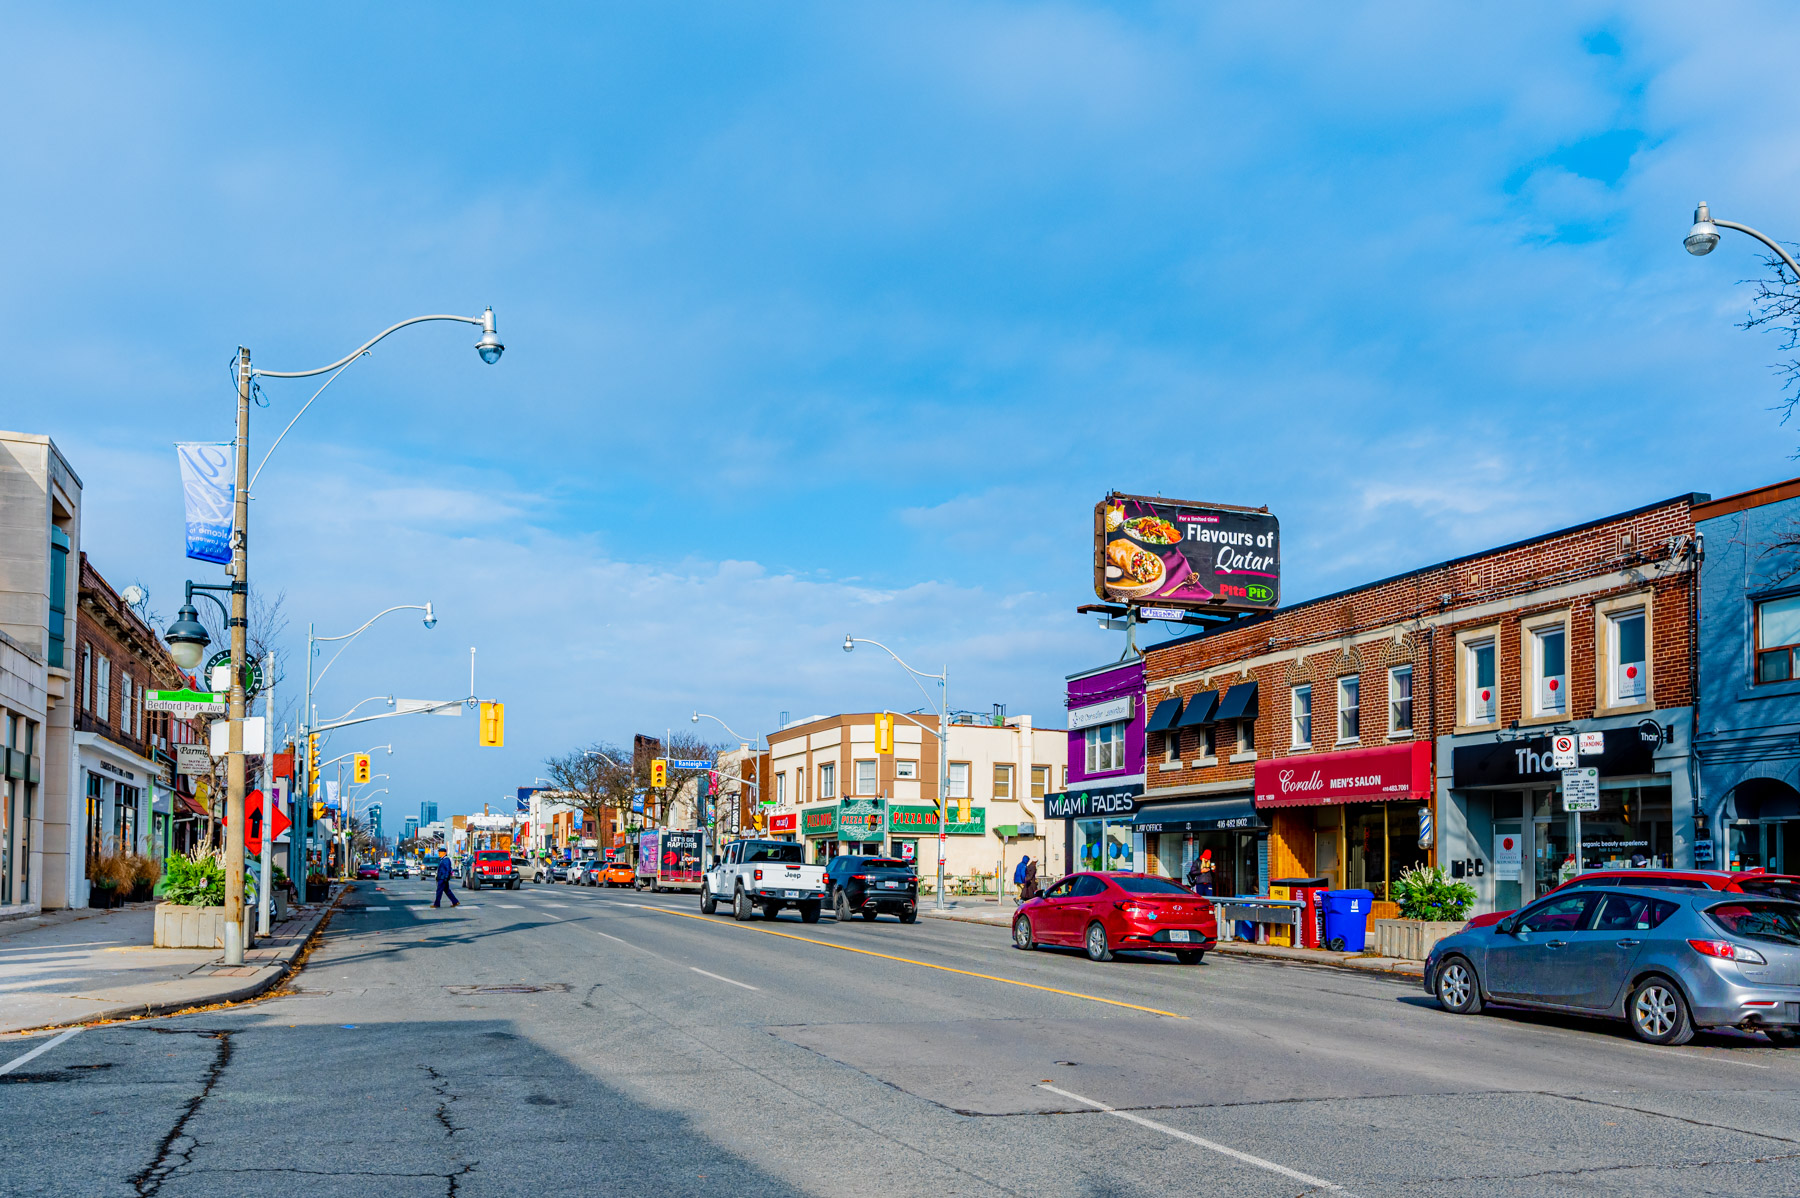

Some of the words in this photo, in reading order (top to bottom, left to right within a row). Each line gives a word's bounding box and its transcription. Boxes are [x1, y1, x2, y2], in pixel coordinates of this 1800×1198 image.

[1187, 524, 1254, 546] Flavours
[1257, 532, 1274, 548] of
[1215, 546, 1274, 573] Qatar
[1220, 584, 1246, 597] Pita
[1248, 586, 1266, 599] Pit
[148, 700, 182, 710] Bedford
[184, 702, 204, 712] Park
[207, 703, 222, 712] Ave
[1641, 732, 1658, 742] Thair
[678, 760, 702, 768] Ranleigh
[1279, 770, 1324, 794] Corallo
[1330, 777, 1354, 789] MEN'S
[1355, 775, 1381, 787] SALON
[1049, 796, 1086, 816] MIAMI
[1092, 792, 1133, 813] FADES
[807, 813, 820, 828] PIZZA
[820, 812, 832, 826] NOVA
[842, 815, 862, 824] PIZZA
[894, 812, 922, 824] PIZZA
